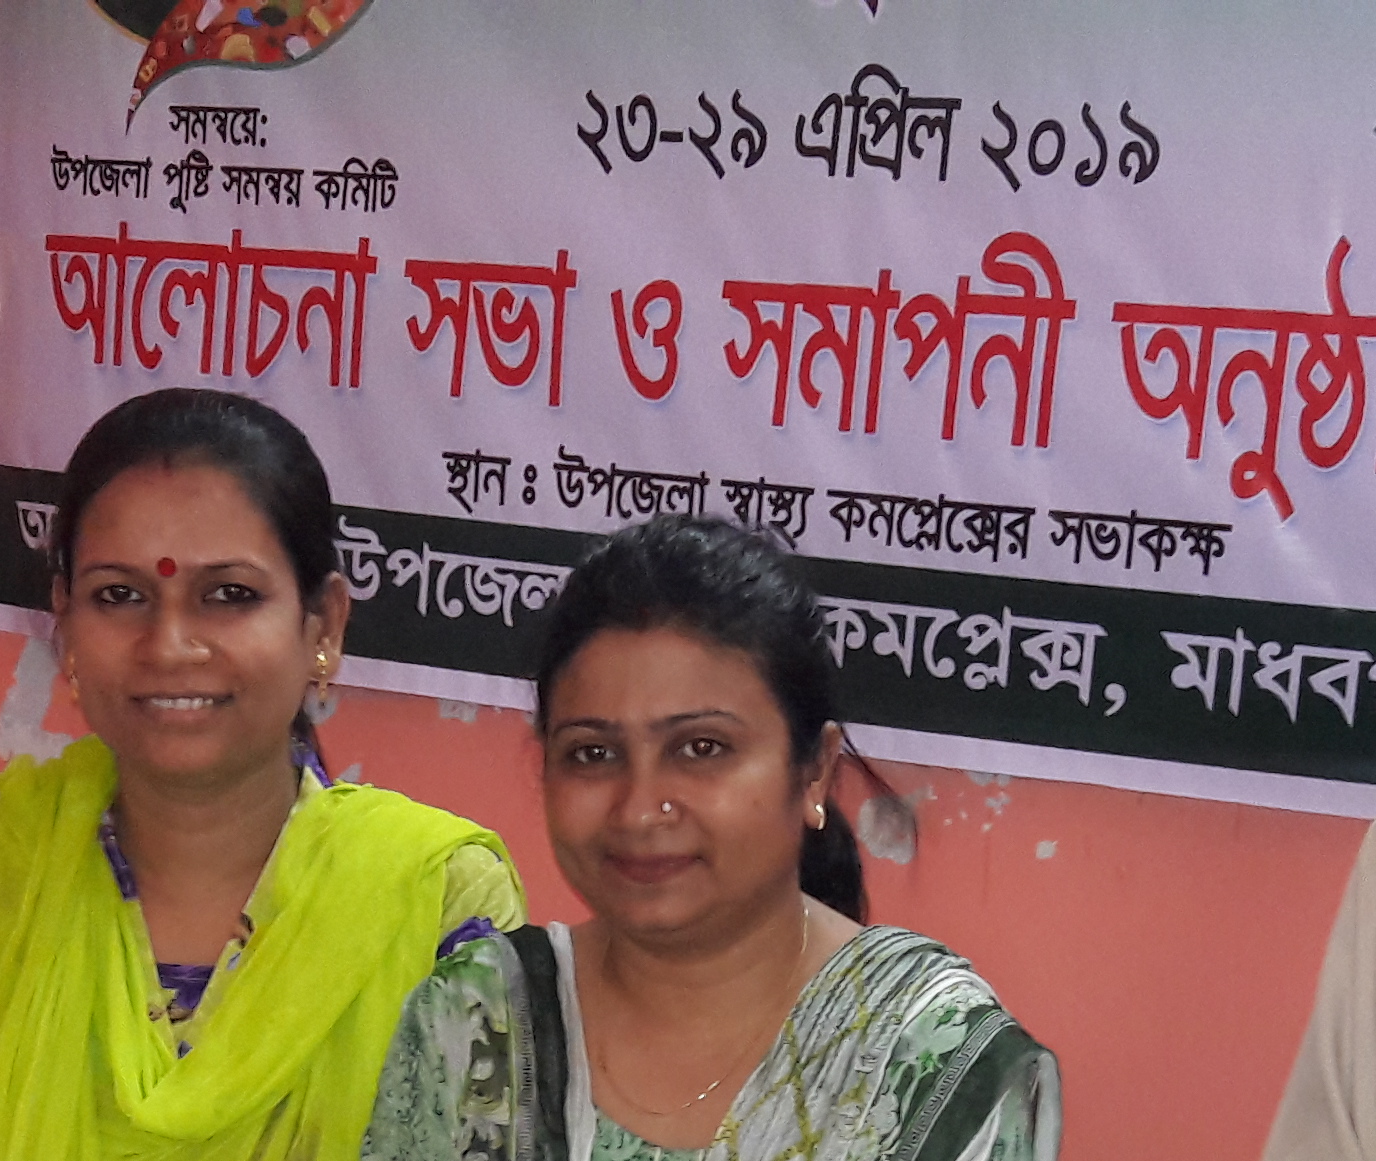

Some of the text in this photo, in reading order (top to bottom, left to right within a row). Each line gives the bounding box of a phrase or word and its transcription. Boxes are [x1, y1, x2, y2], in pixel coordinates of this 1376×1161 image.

[51, 145, 399, 213] উপজেলা পুষ্টি সমন্বয় কমিটি
[576, 63, 1162, 192] ২৩-২৯ এপ্রিল ২০১৯
[45, 222, 377, 389] আলোচনা
[405, 249, 578, 408] সভা
[611, 279, 684, 401] ও
[723, 230, 1076, 449] সমাপনী
[443, 450, 512, 514] স্থান
[554, 445, 711, 520] উপজেলা
[828, 478, 1036, 562] কমপ্লেক্সের
[1050, 510, 1233, 576] সভাকক্ষ
[332, 514, 576, 628] উপজেল
[819, 594, 1128, 717] কমপ্লেক্স,
